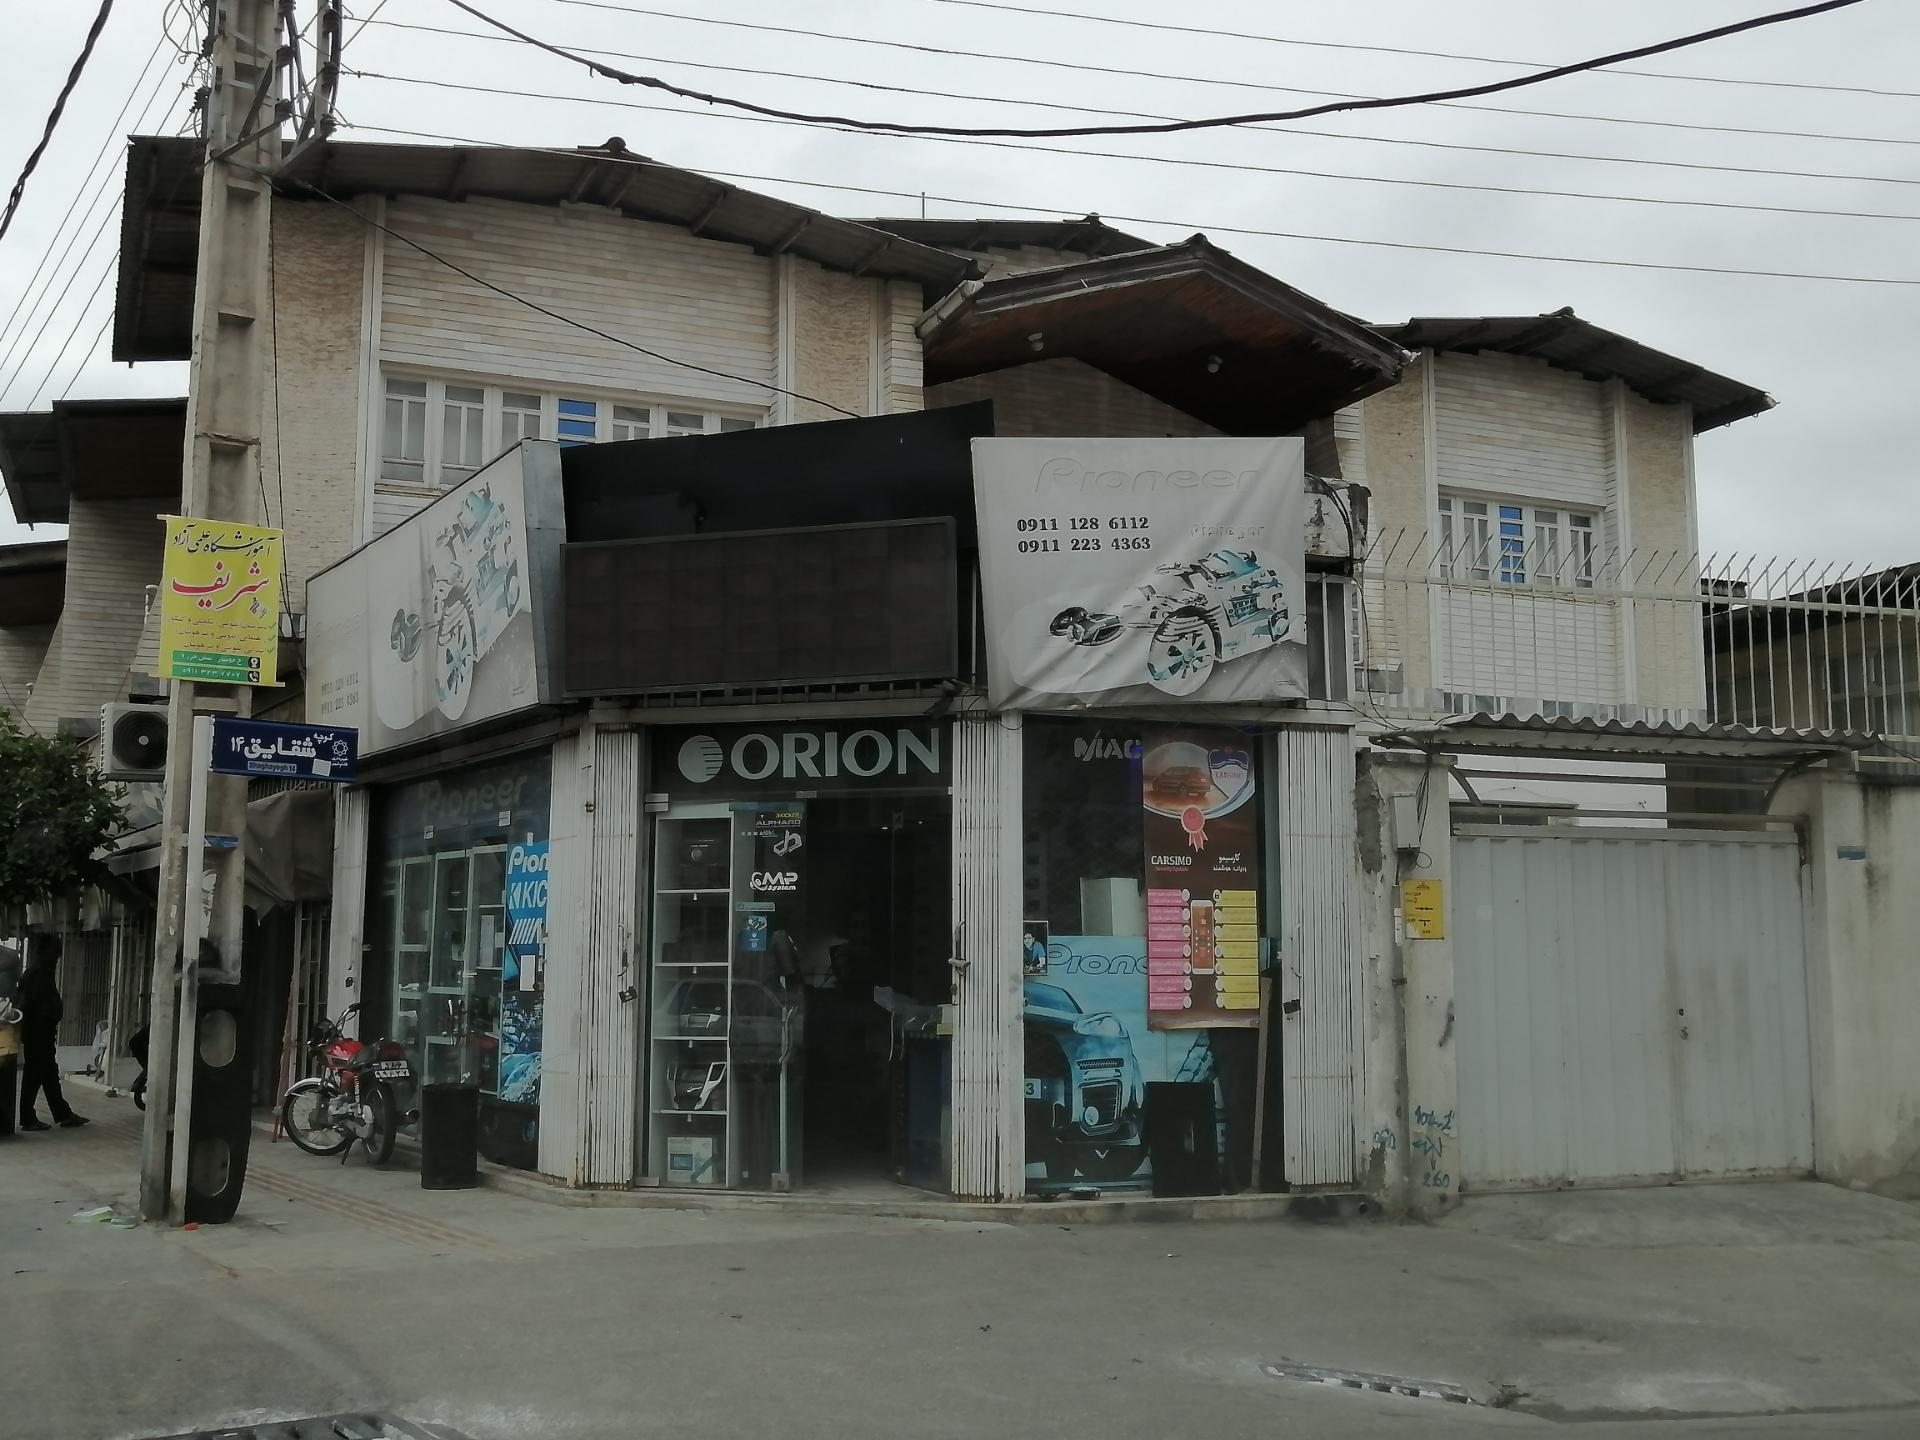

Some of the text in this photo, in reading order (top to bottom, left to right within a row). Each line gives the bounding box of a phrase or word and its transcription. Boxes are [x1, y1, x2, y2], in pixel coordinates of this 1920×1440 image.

[1033, 457, 1265, 493] Pioneer
[1016, 516, 1149, 532] 0911 128 6112
[173, 523, 278, 557] آموزشگاه علمی آزاد
[1017, 537, 1151, 553] 0911 223 4363
[172, 561, 270, 610] شریف
[231, 736, 316, 759] شقایق ۱۴
[313, 733, 334, 744] کوچه
[730, 727, 940, 780] ORION
[1151, 855, 1192, 866] CARSIMO
[1218, 853, 1241, 864] کارسیمو
